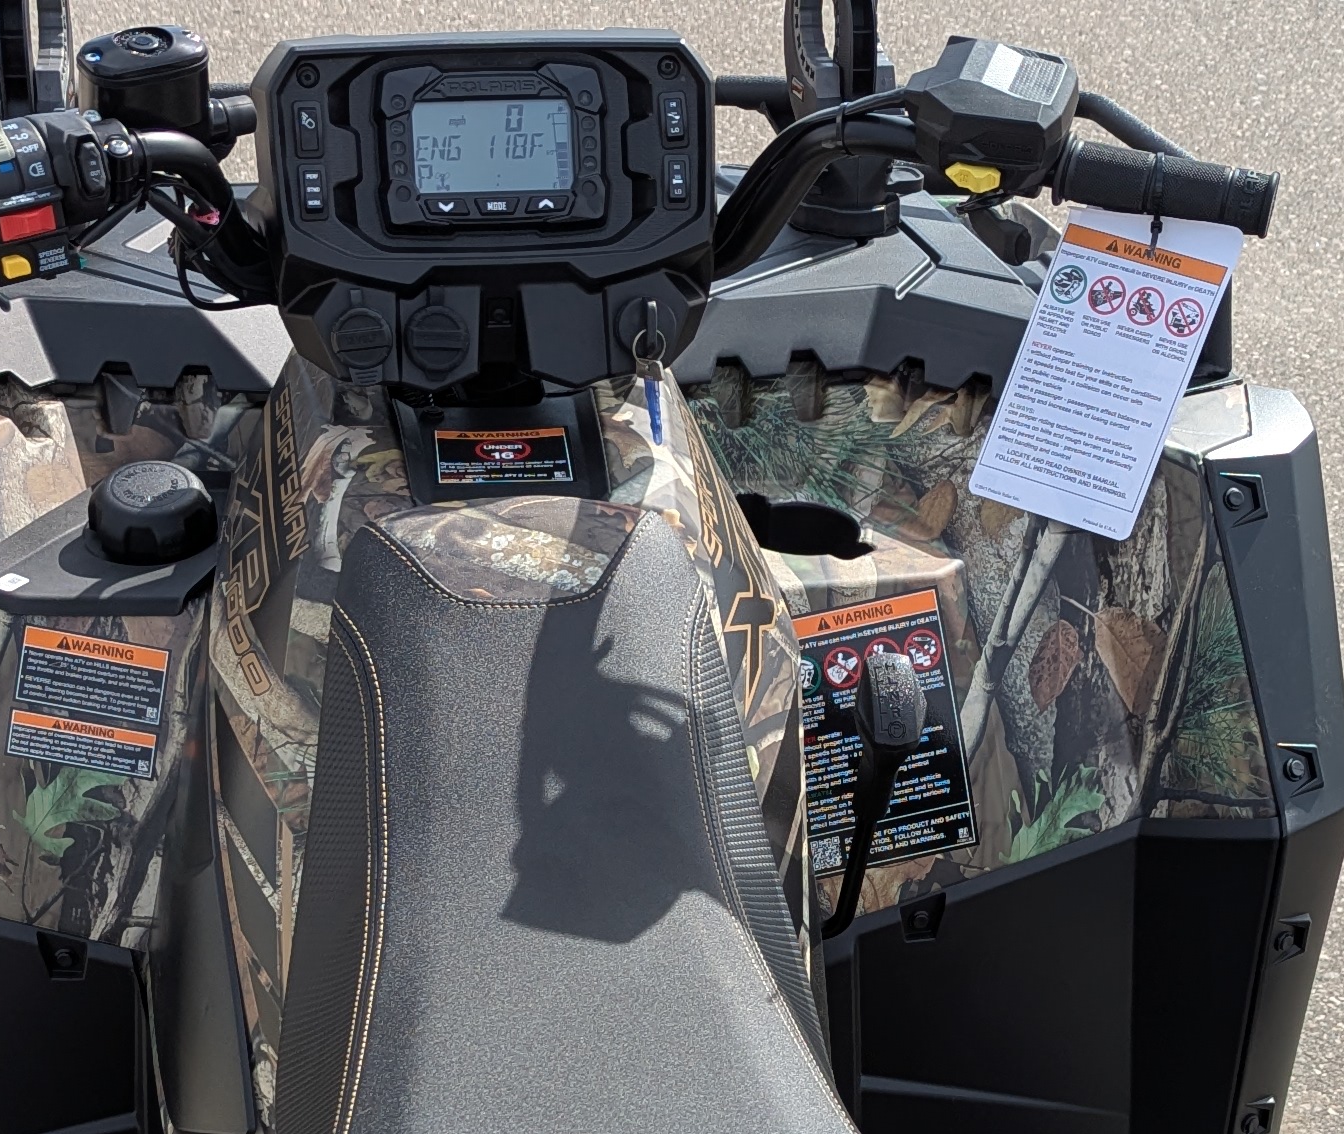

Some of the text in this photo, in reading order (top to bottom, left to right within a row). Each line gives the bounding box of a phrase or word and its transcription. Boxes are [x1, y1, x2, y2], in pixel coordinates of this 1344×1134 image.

[447, 80, 536, 92] POLARIS
[506, 104, 524, 132] 0
[416, 133, 544, 161] ENG 118F
[418, 164, 433, 189] P
[487, 201, 507, 211] MODE
[490, 451, 514, 459] 16
[275, 386, 310, 561] SPORTSMAN
[832, 603, 893, 627] WARNING
[70, 639, 134, 661] WARNING
[63, 721, 114, 738] WARNING
